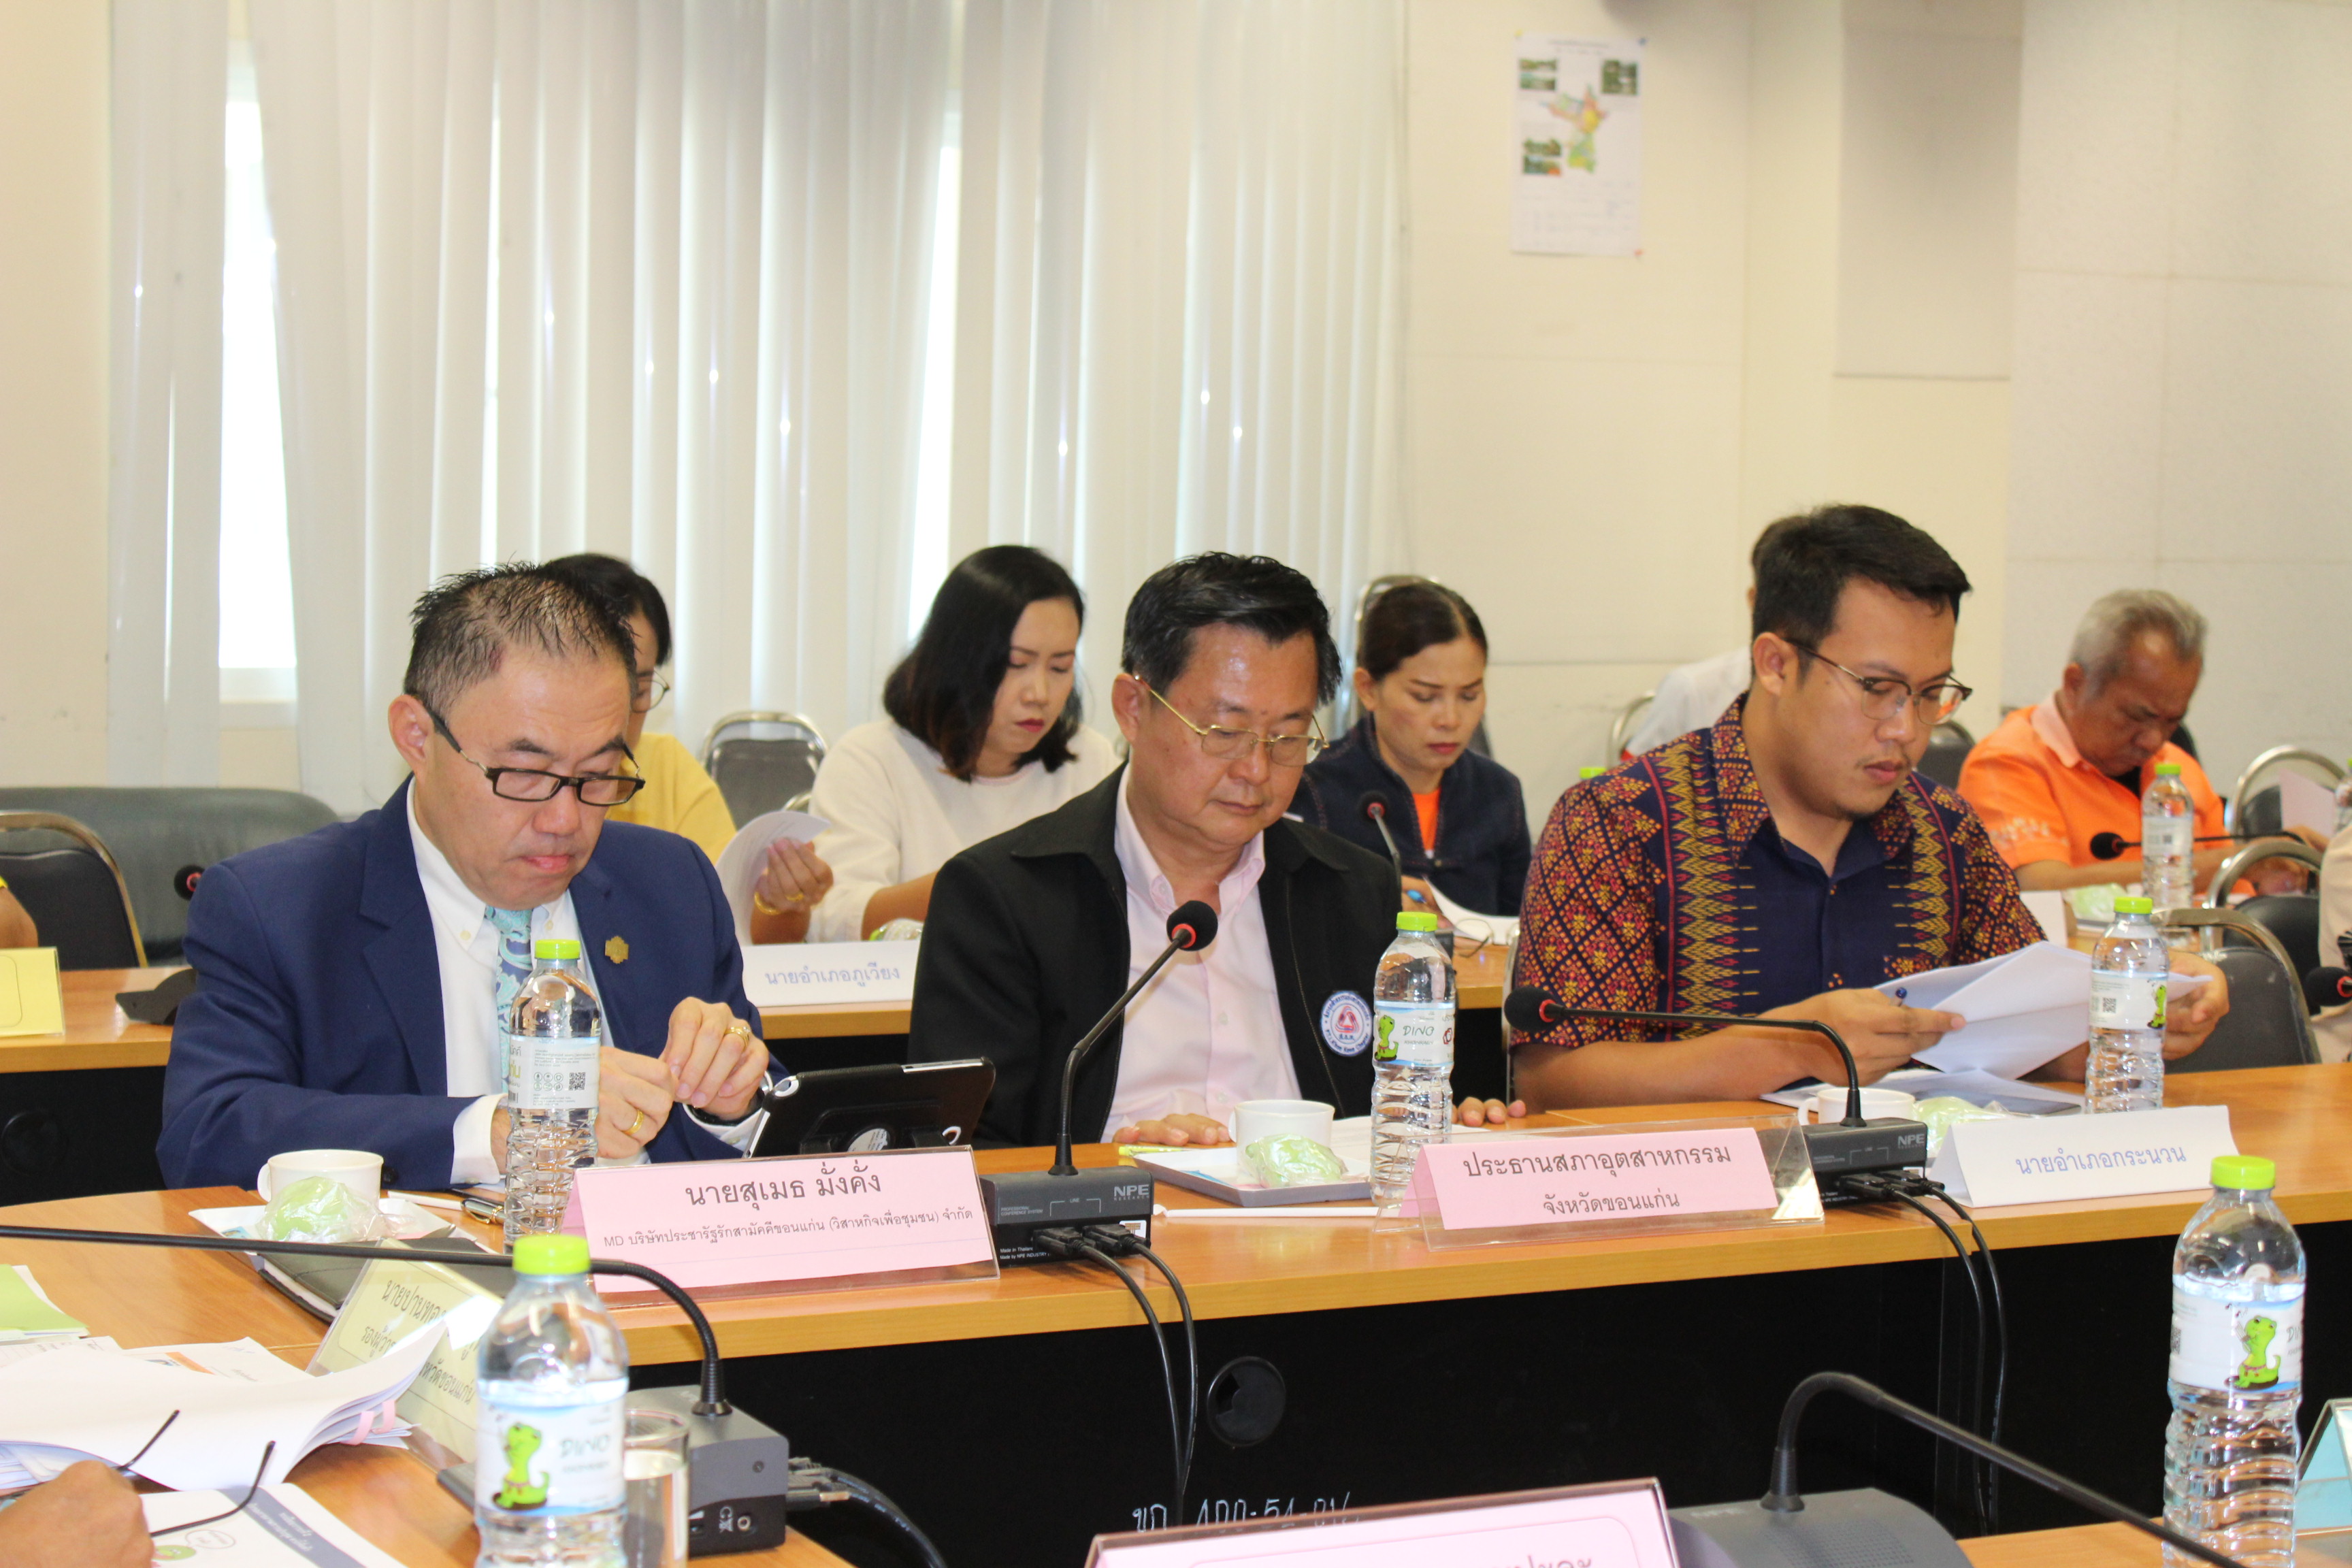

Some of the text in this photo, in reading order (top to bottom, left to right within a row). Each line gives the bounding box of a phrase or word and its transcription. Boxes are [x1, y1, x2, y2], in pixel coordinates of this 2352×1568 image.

[765, 962, 900, 987] นายอำเภอภูเวียง
[1403, 1025, 1435, 1036] DINO
[1897, 1134, 1925, 1146] NPE
[1463, 1144, 1731, 1177] ประธานสภาอุตสาหกรรม
[2015, 1145, 2187, 1175] นายอำเภอกระนวน
[685, 1159, 881, 1211] นายสุเมธ มั่งคั่ง
[1113, 1184, 1149, 1197] NPE
[1543, 1188, 1680, 1215] จังหวัดขอนแก่น
[604, 1235, 625, 1247] MD
[829, 1209, 940, 1232] (วิสาหกิจเพื่อชุมชน)
[943, 1206, 974, 1221] จำกัด
